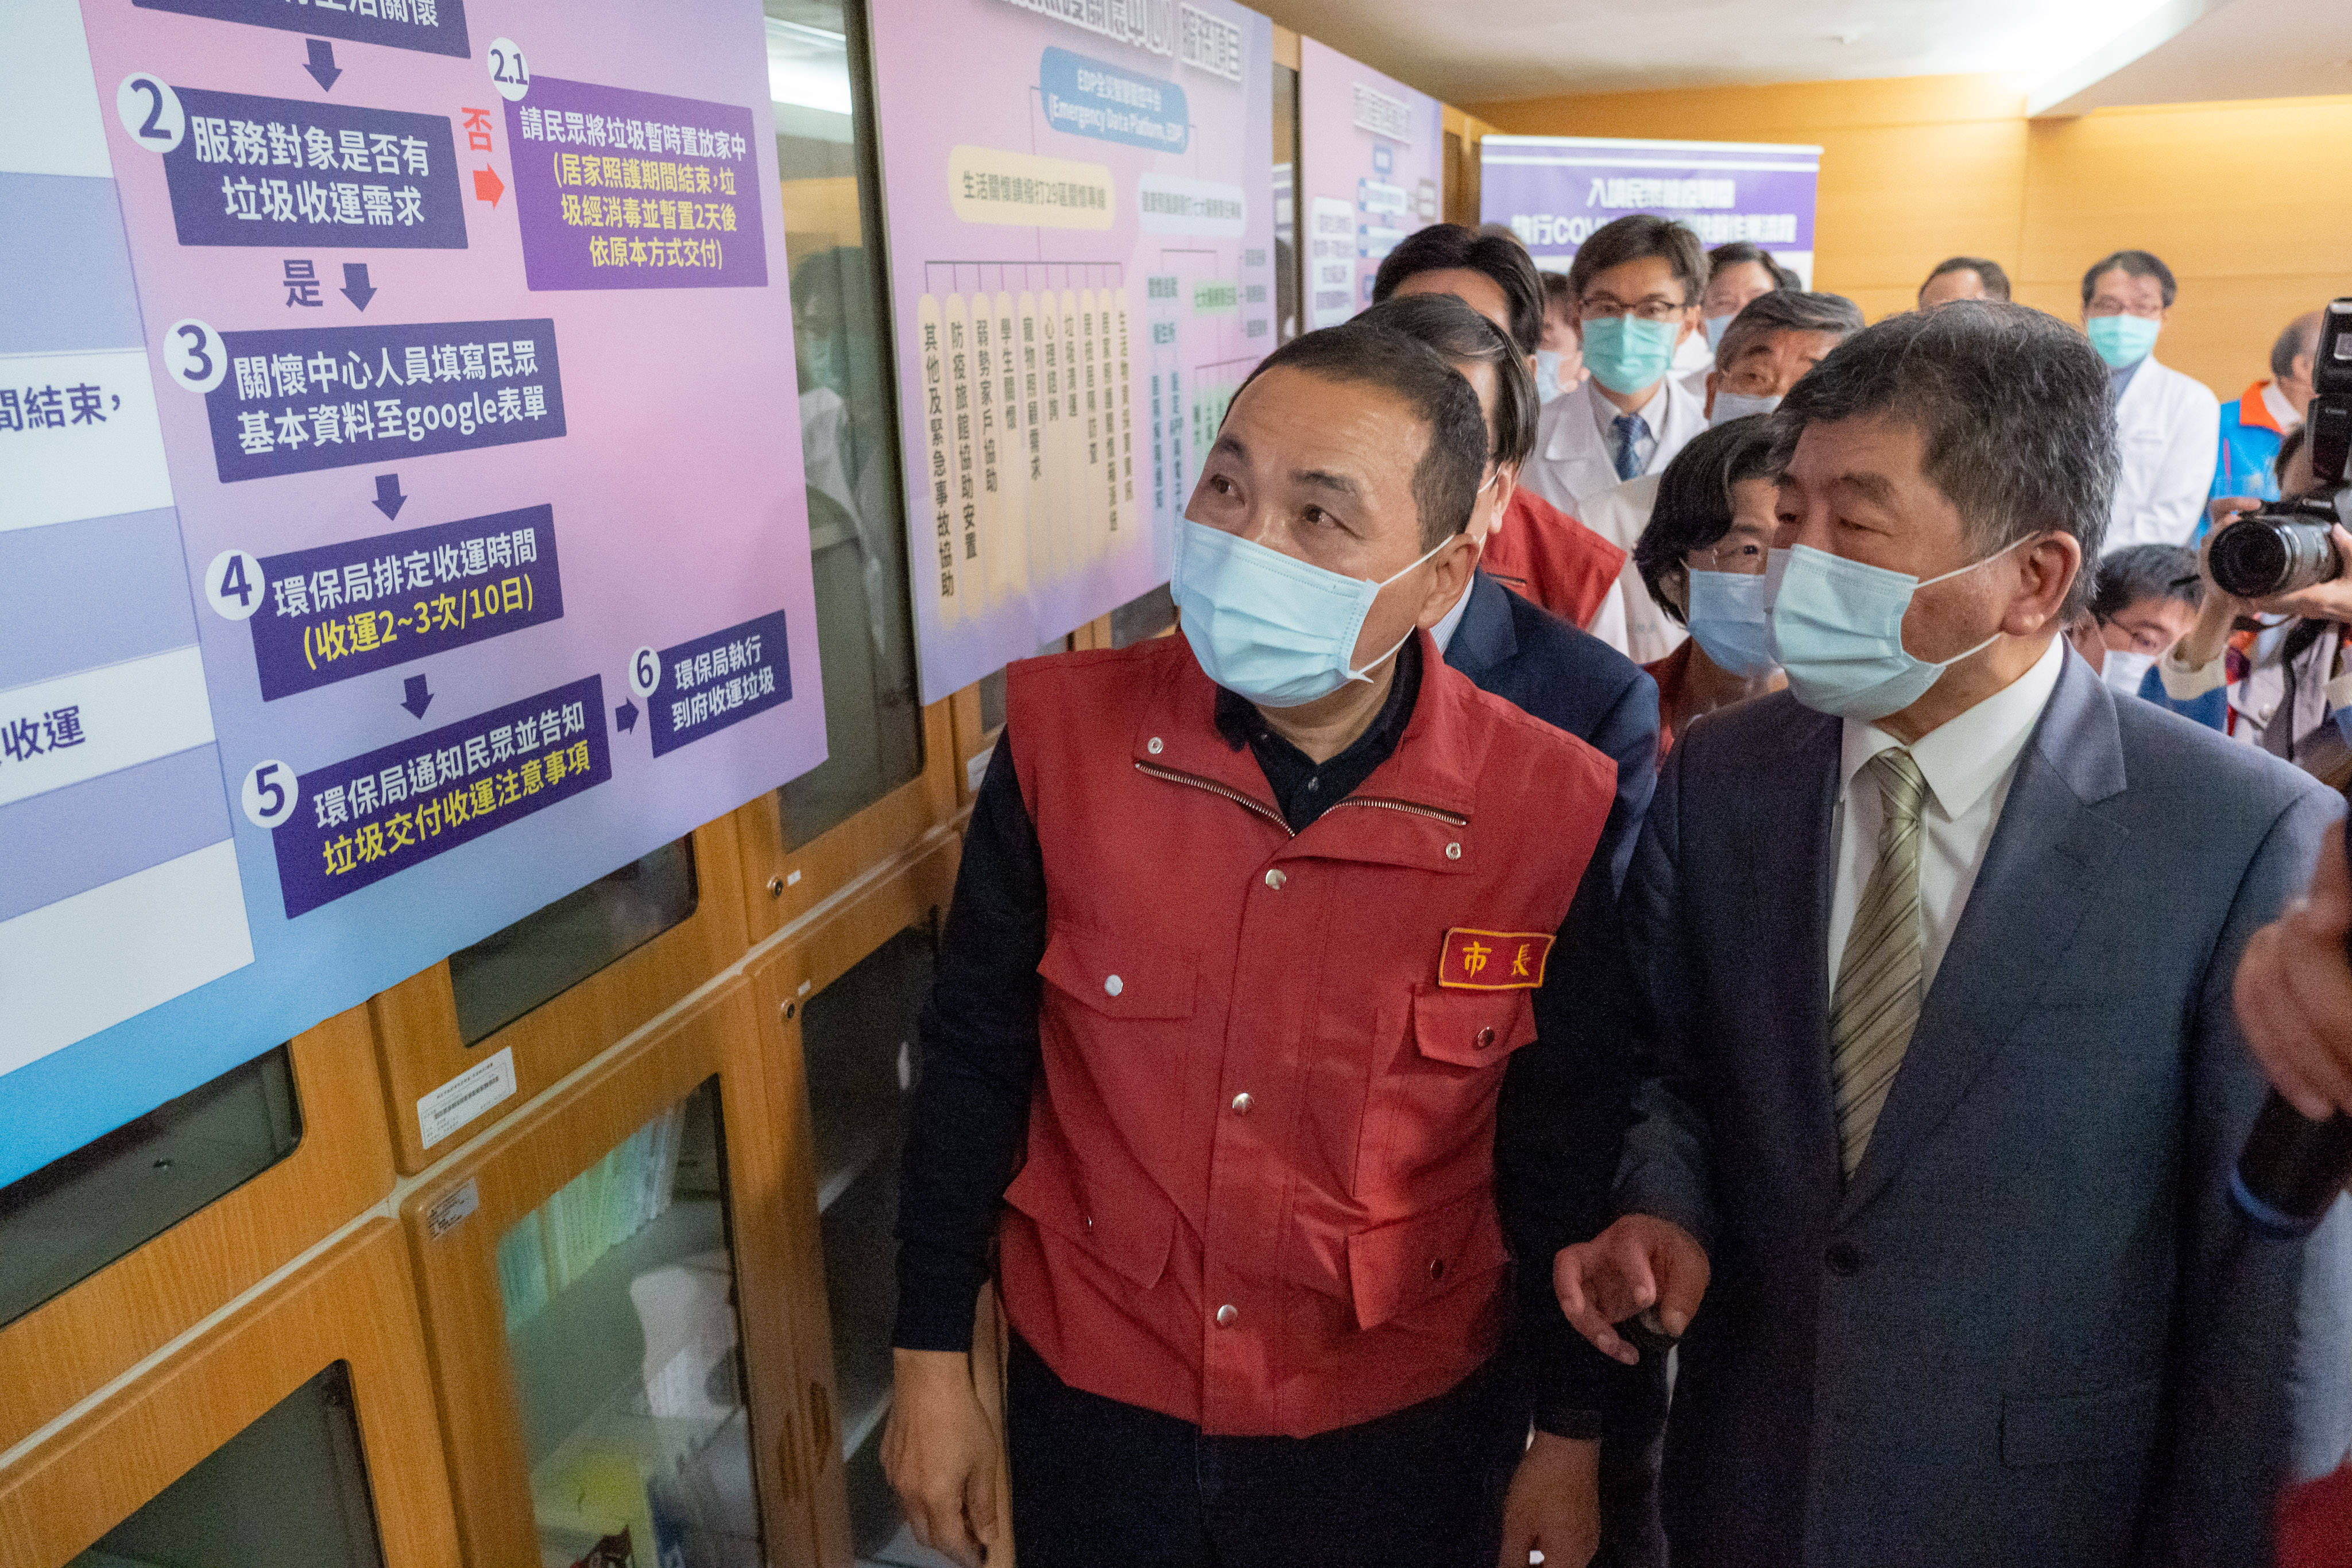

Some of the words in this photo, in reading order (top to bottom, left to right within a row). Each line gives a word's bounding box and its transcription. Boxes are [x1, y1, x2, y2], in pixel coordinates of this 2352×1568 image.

[490, 48, 528, 86] 2.1
[130, 79, 173, 140] 2
[461, 107, 494, 153] 否
[520, 106, 746, 161] 請民眾將垃圾暫時置放家中
[192, 116, 430, 177] 服務對象是否有
[222, 176, 425, 226] 垃圾收運需求
[561, 193, 737, 233] 圾經消毒並暫置2天後
[590, 235, 722, 269] 依原本方式交付)
[283, 260, 324, 308] 是
[176, 324, 214, 381] 3
[234, 340, 538, 401] 關懷中心人員填寫民眾
[237, 385, 547, 455] 基本資料至google表單
[219, 555, 253, 607] 4
[272, 528, 537, 618] 環保局排定收運時間
[304, 573, 533, 671] (收運2~3次/10日)
[636, 649, 654, 690] 6
[675, 634, 762, 690] 環保局執行
[671, 672, 776, 731] 到府收運垃圾
[0, 704, 86, 762] 收運
[256, 764, 285, 818] 5
[313, 700, 586, 830] 環保局通知民眾並告知
[322, 740, 591, 879] 垃圾交付收運注意事項
